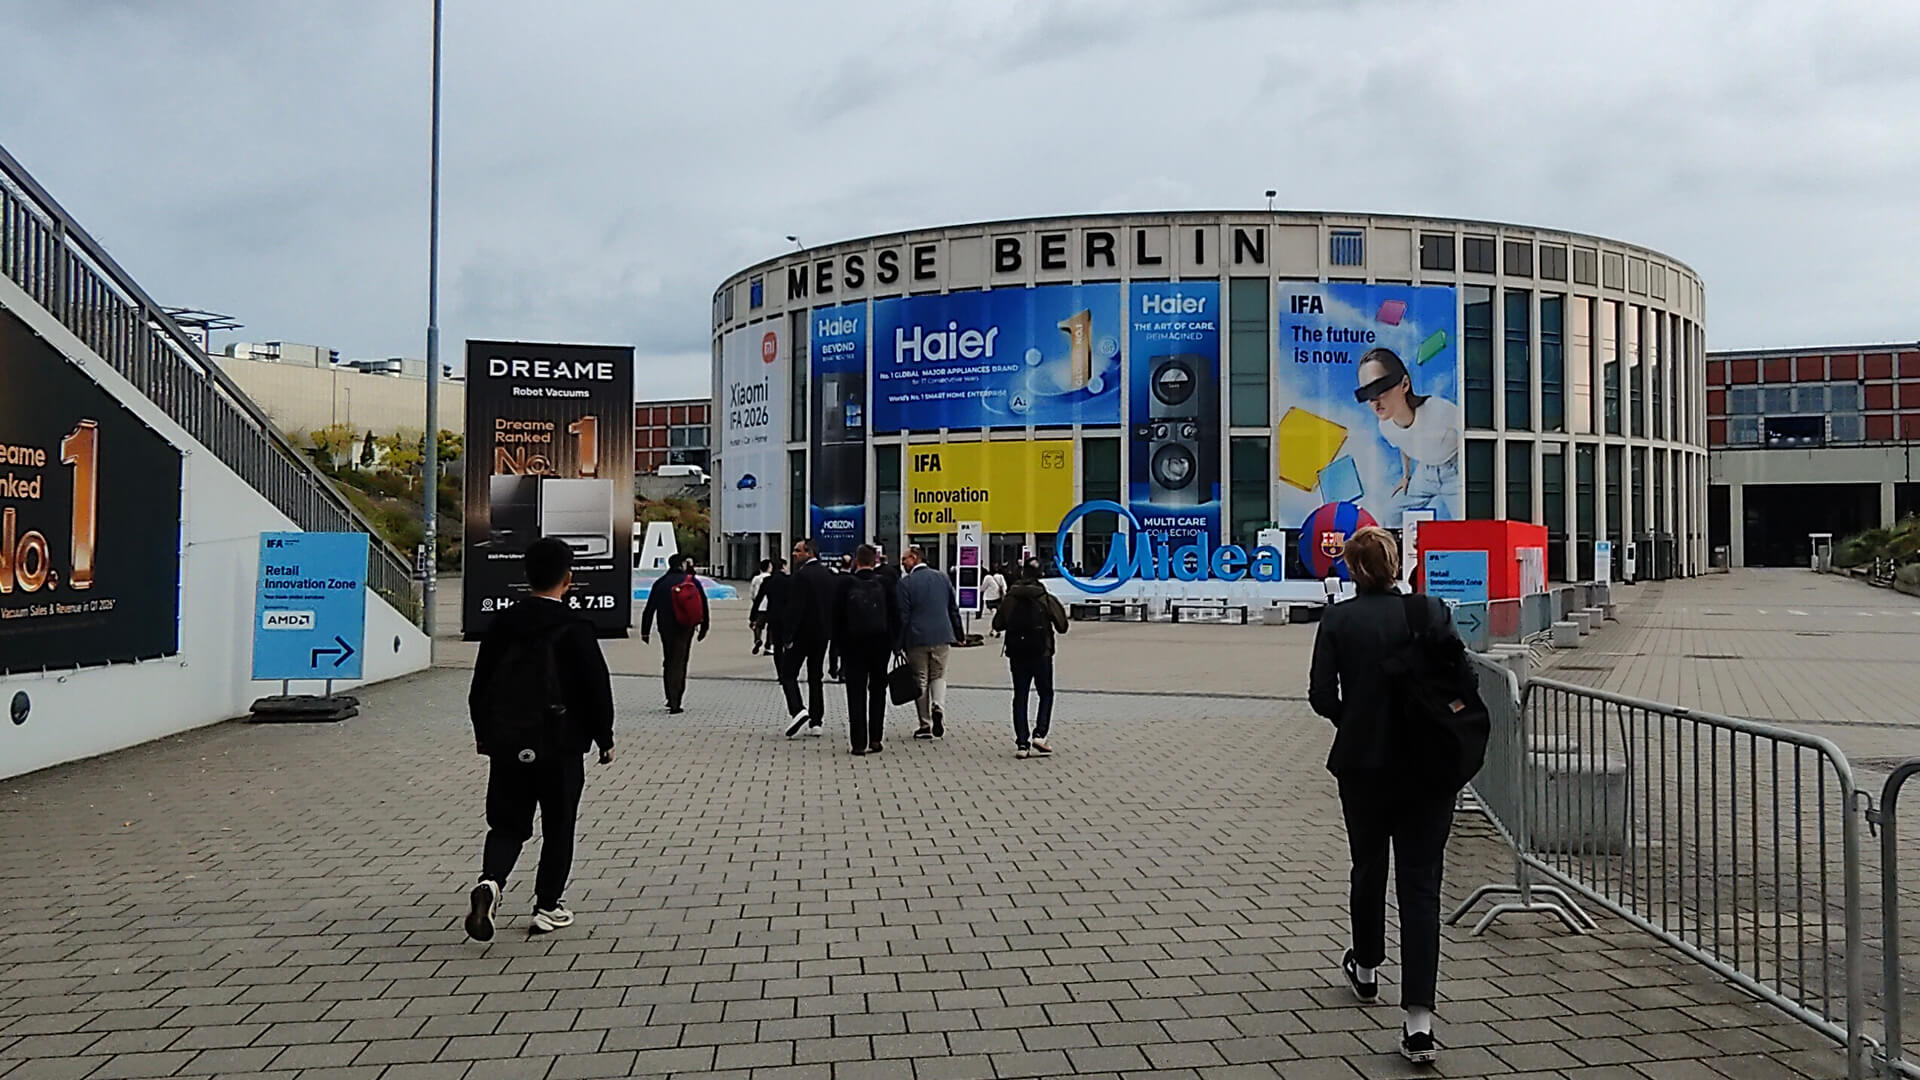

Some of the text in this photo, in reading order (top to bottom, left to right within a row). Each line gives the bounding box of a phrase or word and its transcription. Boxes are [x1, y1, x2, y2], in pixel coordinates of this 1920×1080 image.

[788, 228, 1265, 300] MESSE BERLIN
[1142, 293, 1206, 315] Haier
[1291, 295, 1323, 314] IFA
[819, 316, 858, 337] Haier
[1134, 323, 1151, 331] THE
[1154, 322, 1172, 330] ART
[1174, 322, 1187, 330] OF
[1146, 332, 1203, 340] REIMAGINED
[1291, 325, 1376, 343] The future
[822, 342, 855, 354] BEYOND
[895, 321, 998, 364] Haier
[1294, 346, 1352, 364] is now.
[489, 359, 614, 380] DREAME
[895, 371, 919, 379] GLOBAL
[922, 368, 946, 376] MAJOR
[947, 366, 990, 374] APPLIANCES
[992, 364, 1019, 373] BRAND
[513, 387, 590, 398] Robot Vacuums
[730, 376, 768, 408] Xiaomi
[925, 392, 945, 400] SMART
[744, 405, 769, 428] 2026
[495, 419, 555, 431] Dreame
[495, 431, 551, 443] Ranked
[568, 415, 598, 479] 1
[915, 453, 942, 472] IFA
[914, 486, 989, 504] Innovation
[60, 419, 98, 590] 1
[914, 507, 956, 524] for all.
[1144, 517, 1207, 526] MULTI CARE
[824, 520, 855, 529] HORIZON
[1146, 528, 1205, 537] COECTIO
[266, 539, 284, 548] IFA
[265, 565, 299, 576] Retail
[264, 578, 356, 589] Innovation Zone
[30, 604, 47, 616] Sales
[56, 603, 81, 614] Revenue
[568, 596, 615, 609] & 7.1B
[267, 616, 298, 625] AMD
